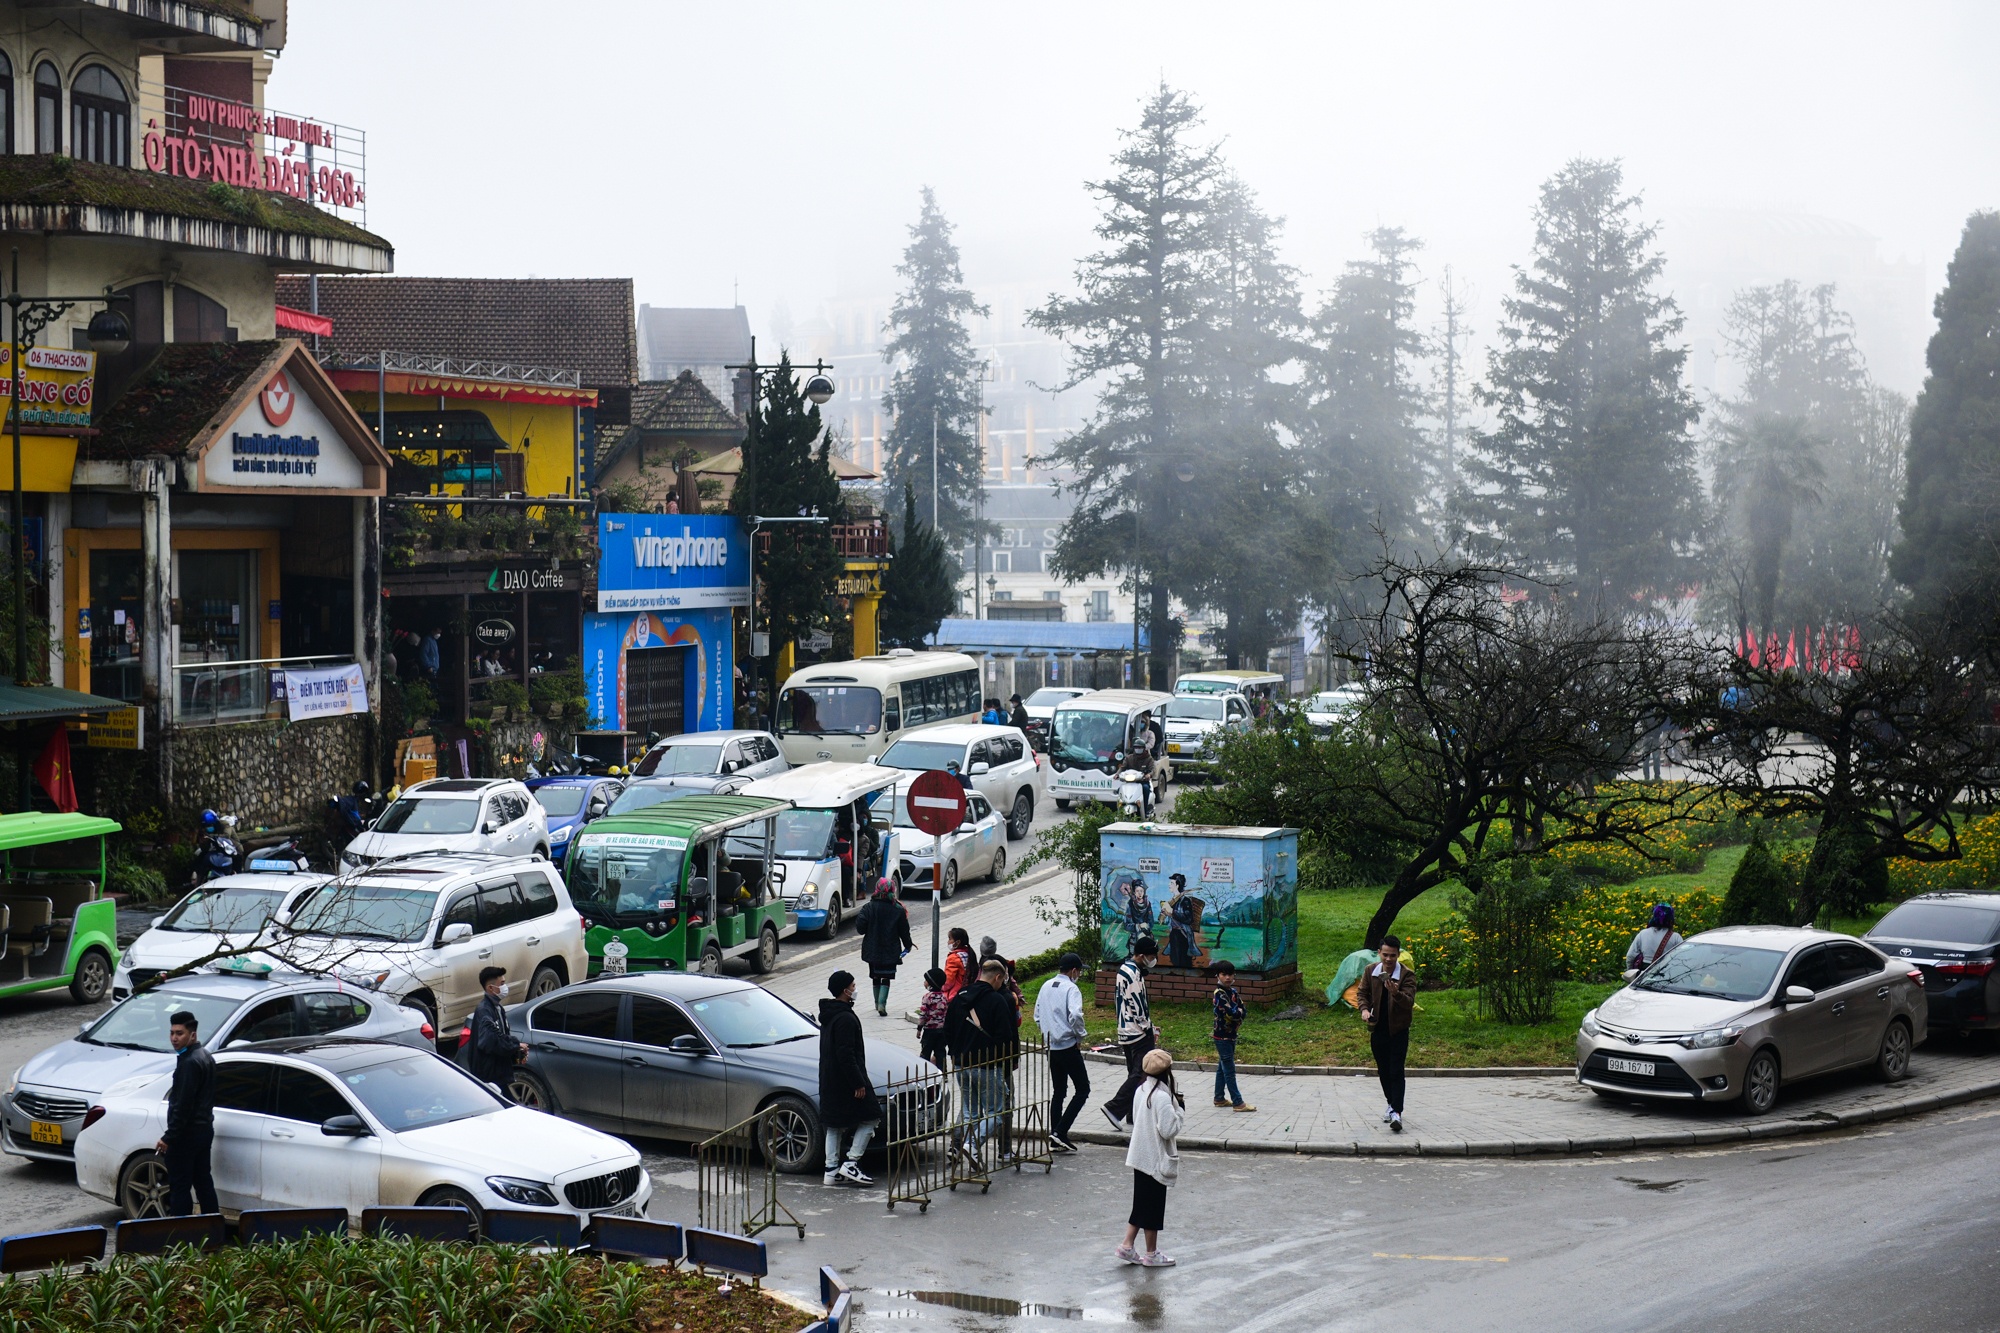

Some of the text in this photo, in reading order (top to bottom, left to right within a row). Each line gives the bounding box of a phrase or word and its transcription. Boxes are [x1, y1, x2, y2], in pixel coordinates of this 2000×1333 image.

[188, 95, 216, 124] DUY
[210, 138, 266, 190] NHÀ
[263, 142, 309, 200] ĐẤT
[319, 165, 355, 208] 968
[31, 351, 88, 368] 06 THẠCH SƠN
[64, 378, 93, 405] CỐ
[633, 525, 728, 575] vinaphone
[503, 569, 564, 590] DAO Coffee
[479, 627, 509, 641] Take away
[608, 957, 623, 966] 24HC
[1609, 1059, 1654, 1075] 99A-167.12
[38, 1123, 53, 1133] 24A
[33, 1131, 59, 1144] 078.32
